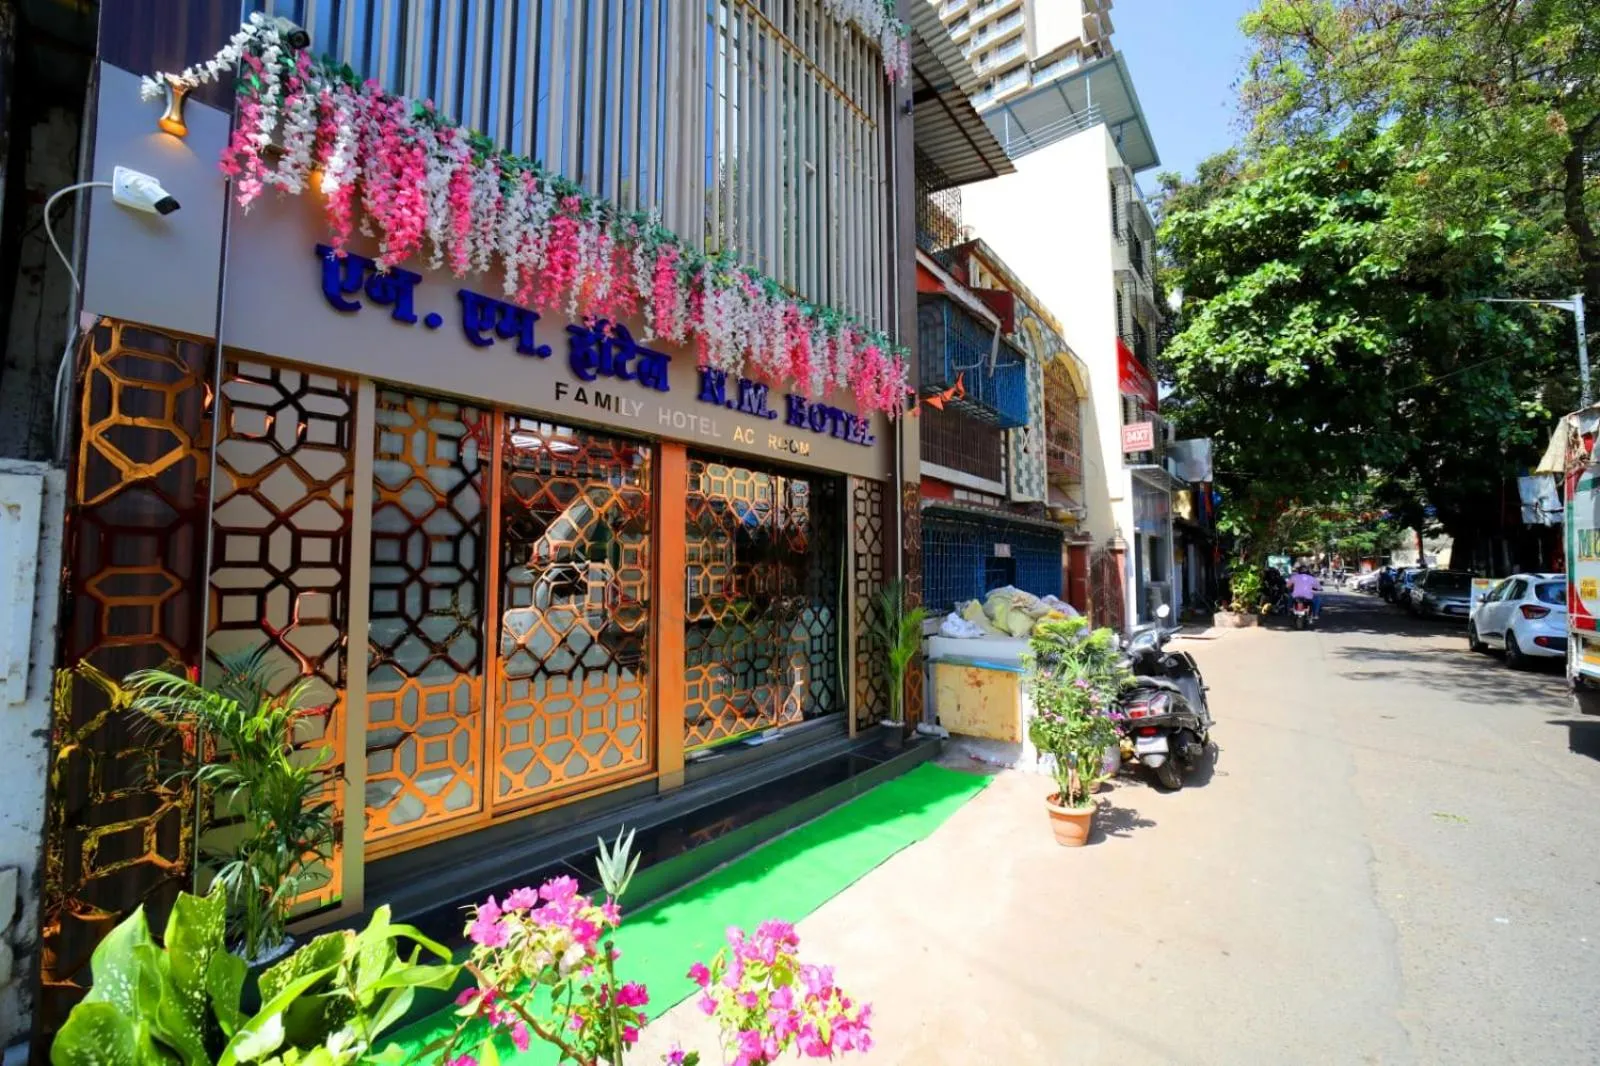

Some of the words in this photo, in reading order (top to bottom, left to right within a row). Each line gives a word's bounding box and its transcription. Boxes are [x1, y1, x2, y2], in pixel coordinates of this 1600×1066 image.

[457, 288, 552, 358] एम.
[554, 381, 645, 418] FAMILY
[658, 406, 721, 438] HOTEL
[733, 425, 755, 445] AC
[767, 433, 810, 457] ROOM
[785, 393, 877, 447] HOTEL
